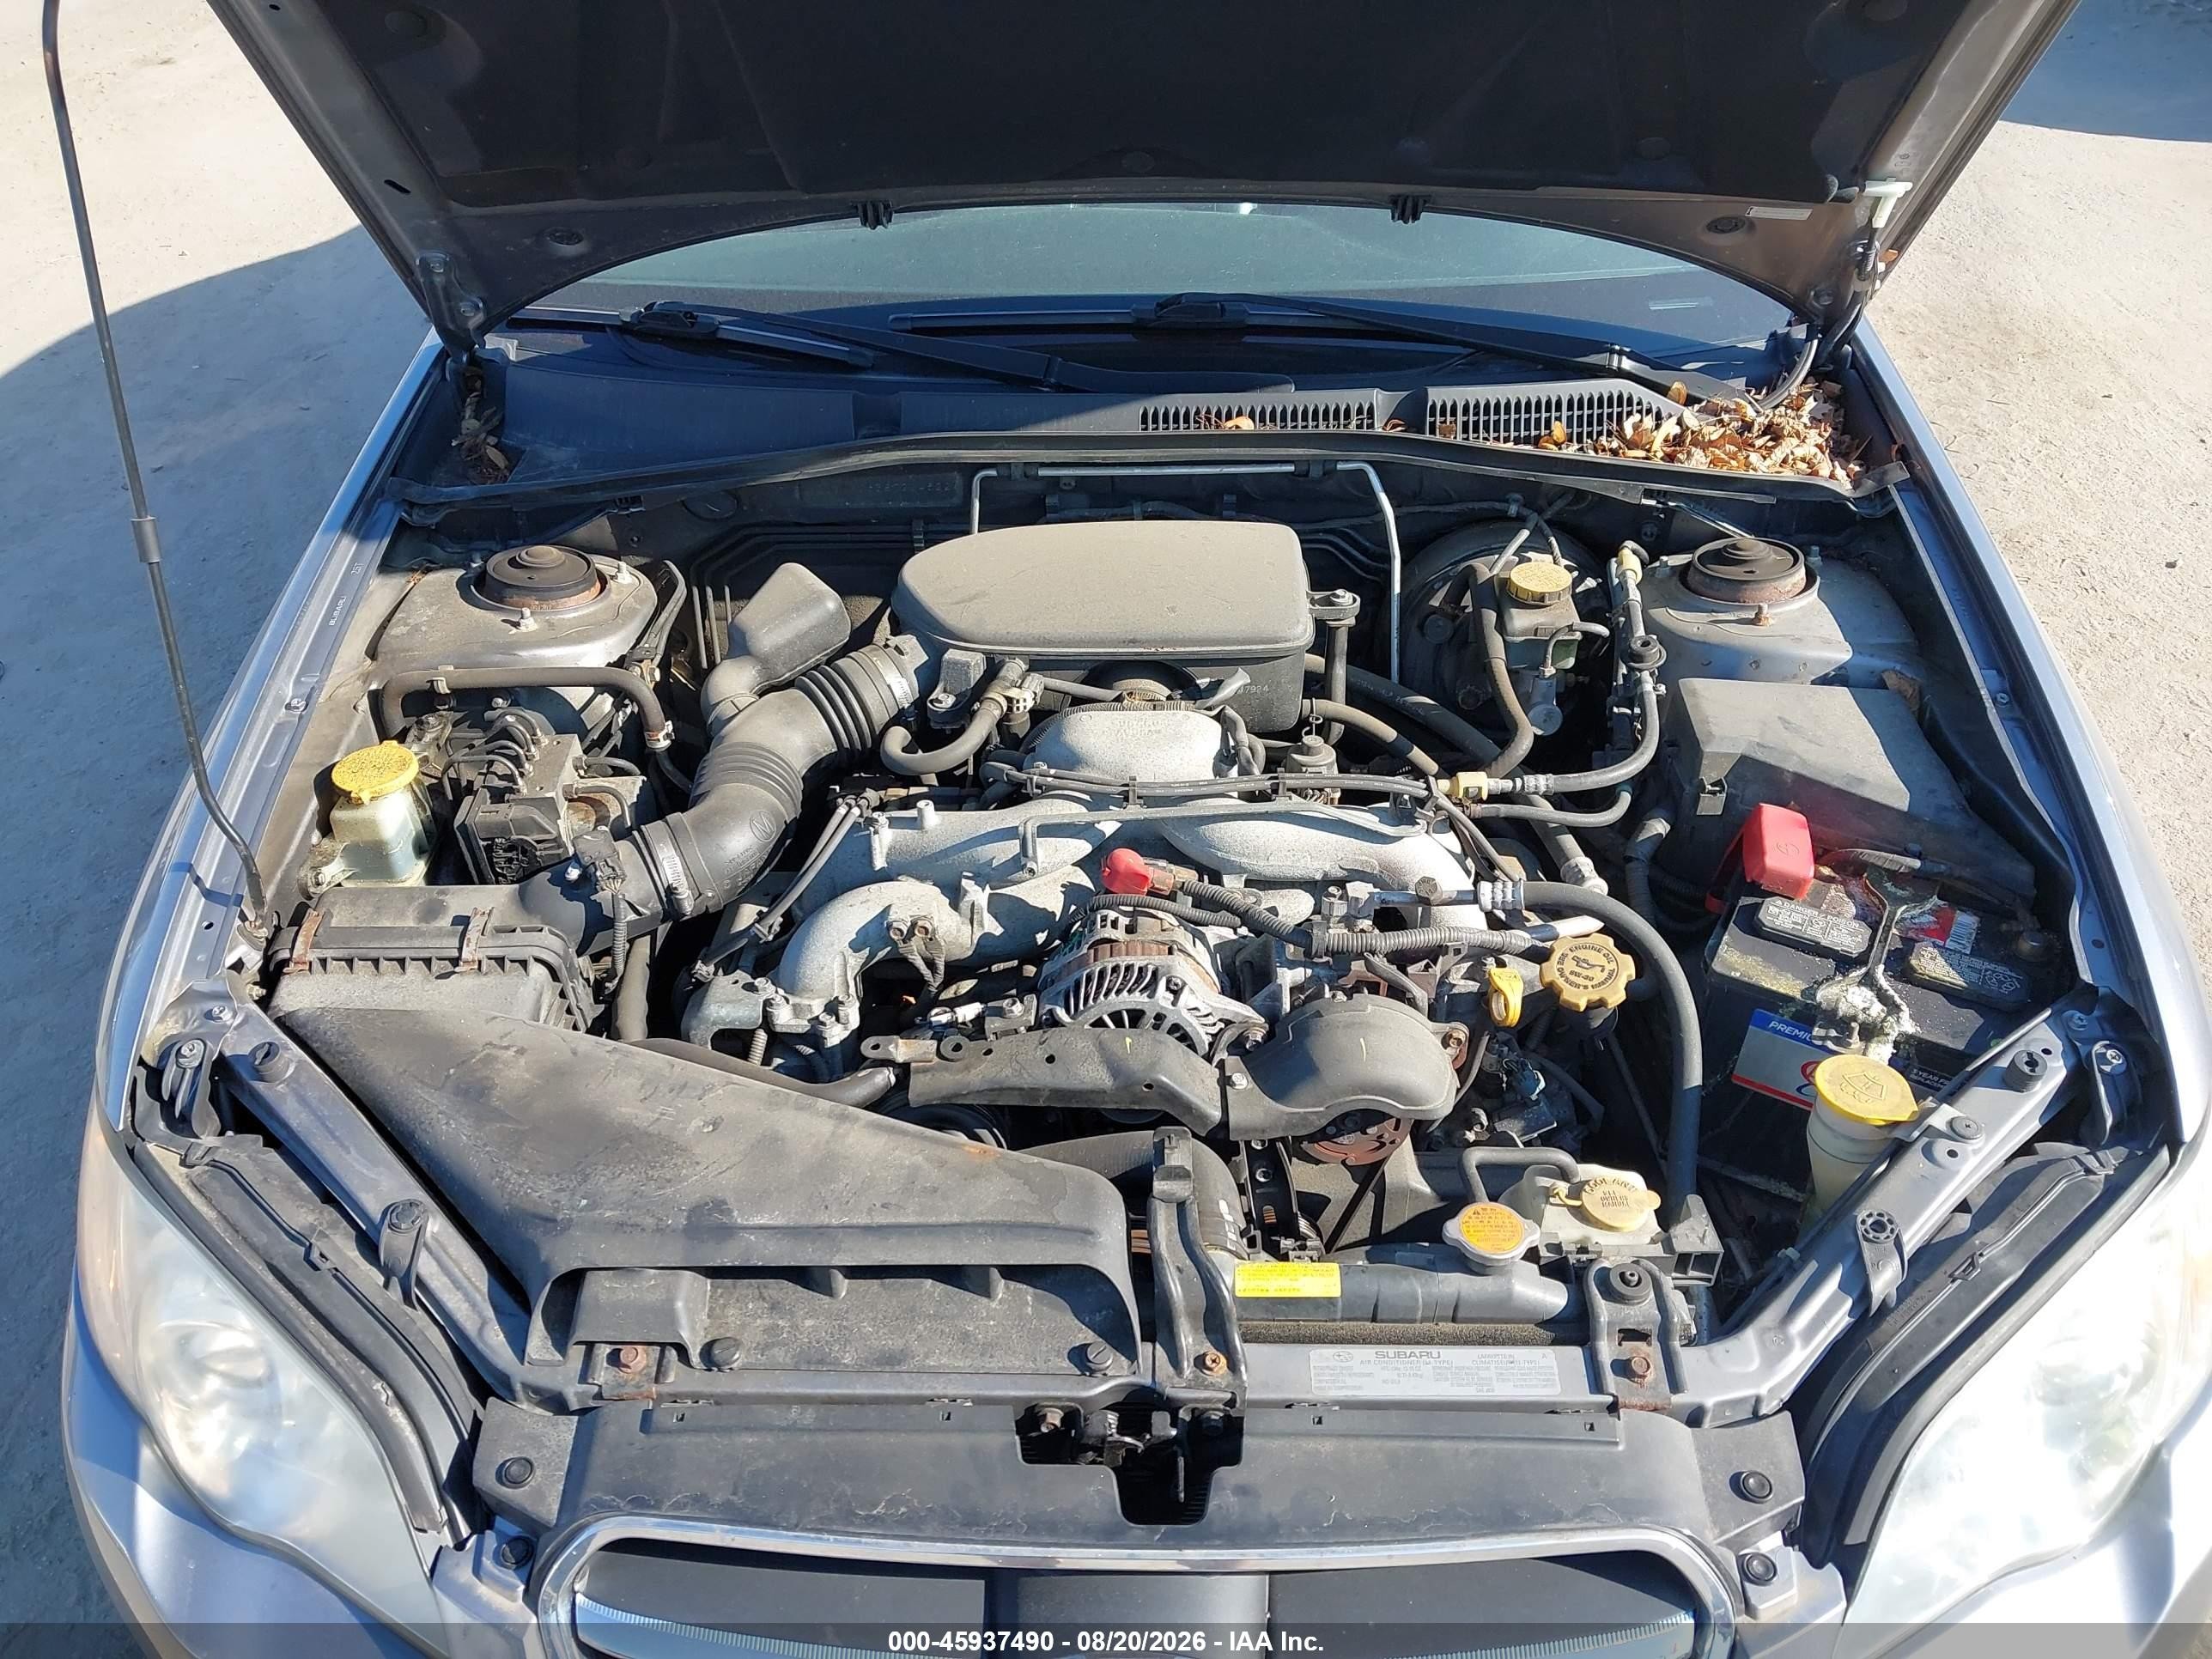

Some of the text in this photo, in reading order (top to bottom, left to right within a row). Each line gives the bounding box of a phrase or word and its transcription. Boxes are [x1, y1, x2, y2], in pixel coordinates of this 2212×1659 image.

[1784, 901, 1819, 916] DANGER
[1826, 915, 1860, 928] POISON
[1569, 944, 1614, 964] ENGINE OIL
[1590, 968, 1616, 990] MANUAL
[1374, 1351, 1441, 1359] SUBARU
